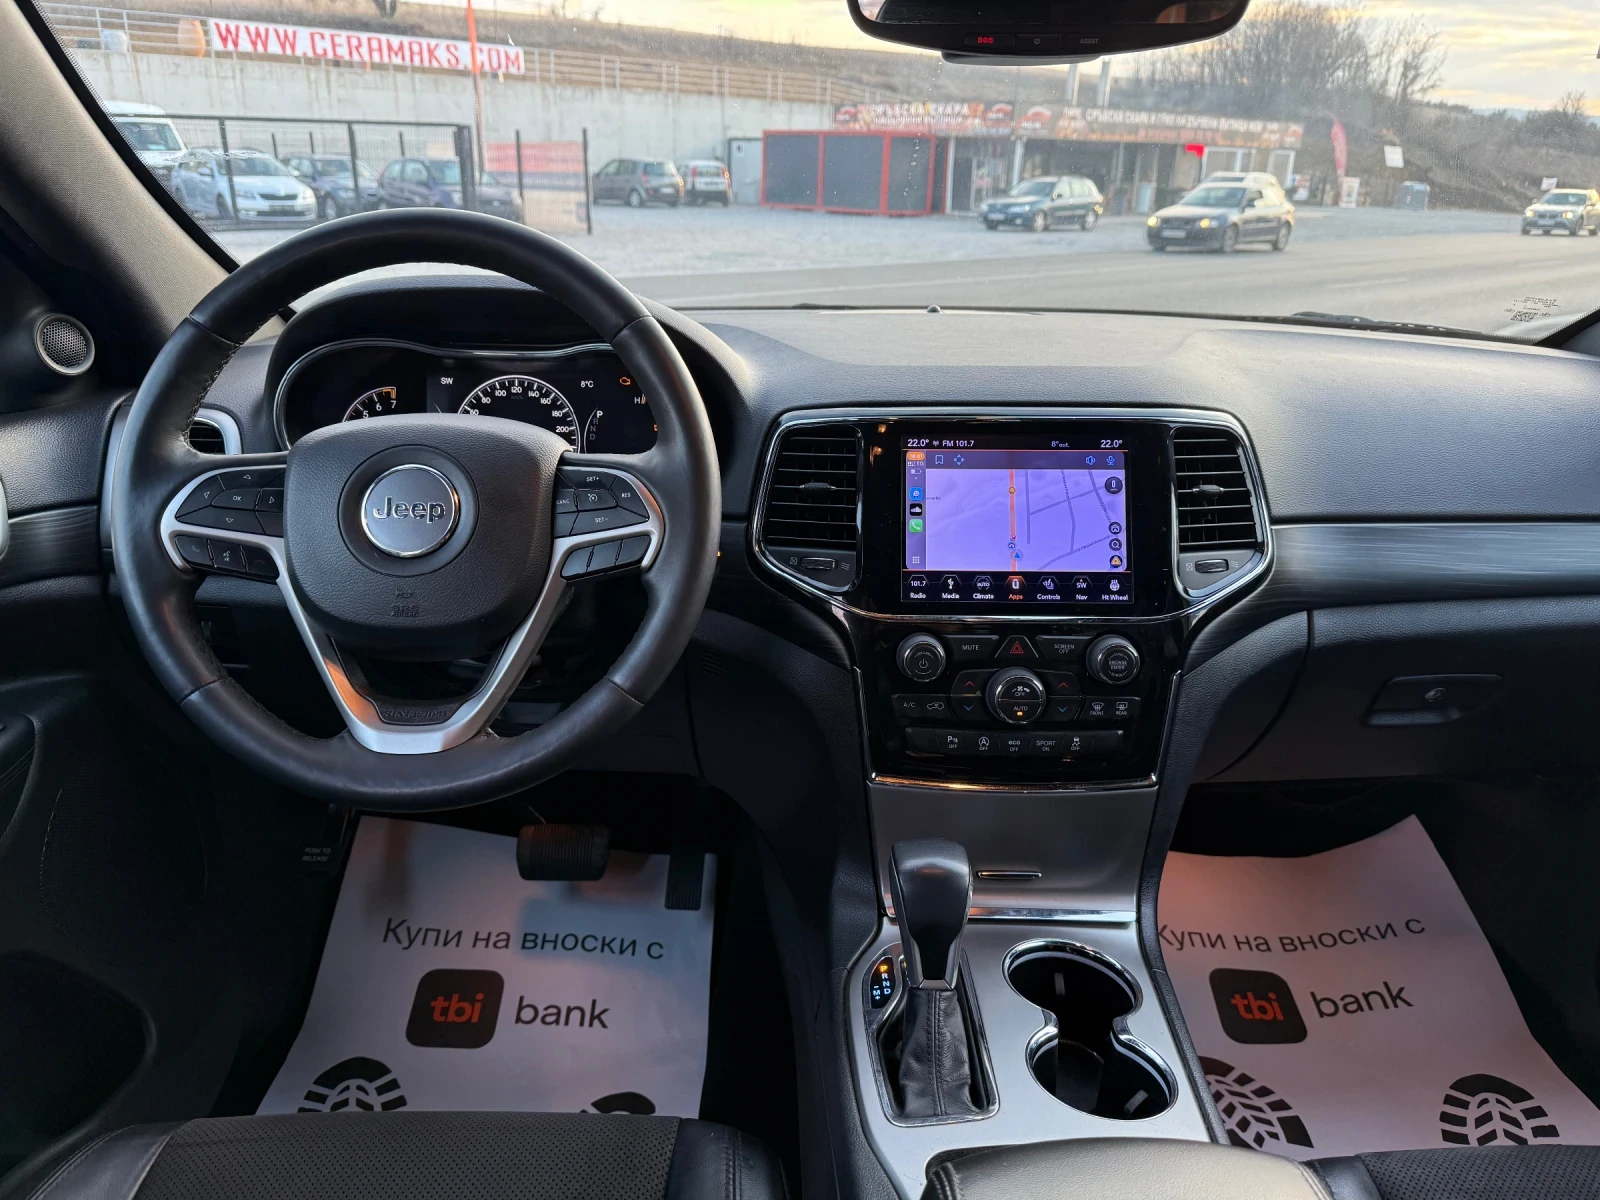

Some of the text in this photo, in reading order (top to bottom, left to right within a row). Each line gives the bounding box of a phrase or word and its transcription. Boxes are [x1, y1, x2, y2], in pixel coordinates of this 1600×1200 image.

[440, 377, 454, 385] SW
[376, 402, 382, 411] 6
[363, 410, 369, 419] 5
[596, 410, 603, 418] P
[908, 438, 930, 447] 22.0°
[1100, 440, 1123, 448] 22.0°
[373, 496, 446, 524] Jeep
[382, 917, 664, 960] Купи на вноски с
[1234, 934, 1272, 953] на
[1278, 922, 1398, 953] вноски
[1405, 918, 1425, 934] с
[1230, 981, 1414, 1021] tbi bank
[430, 992, 610, 1029] tbi bank
